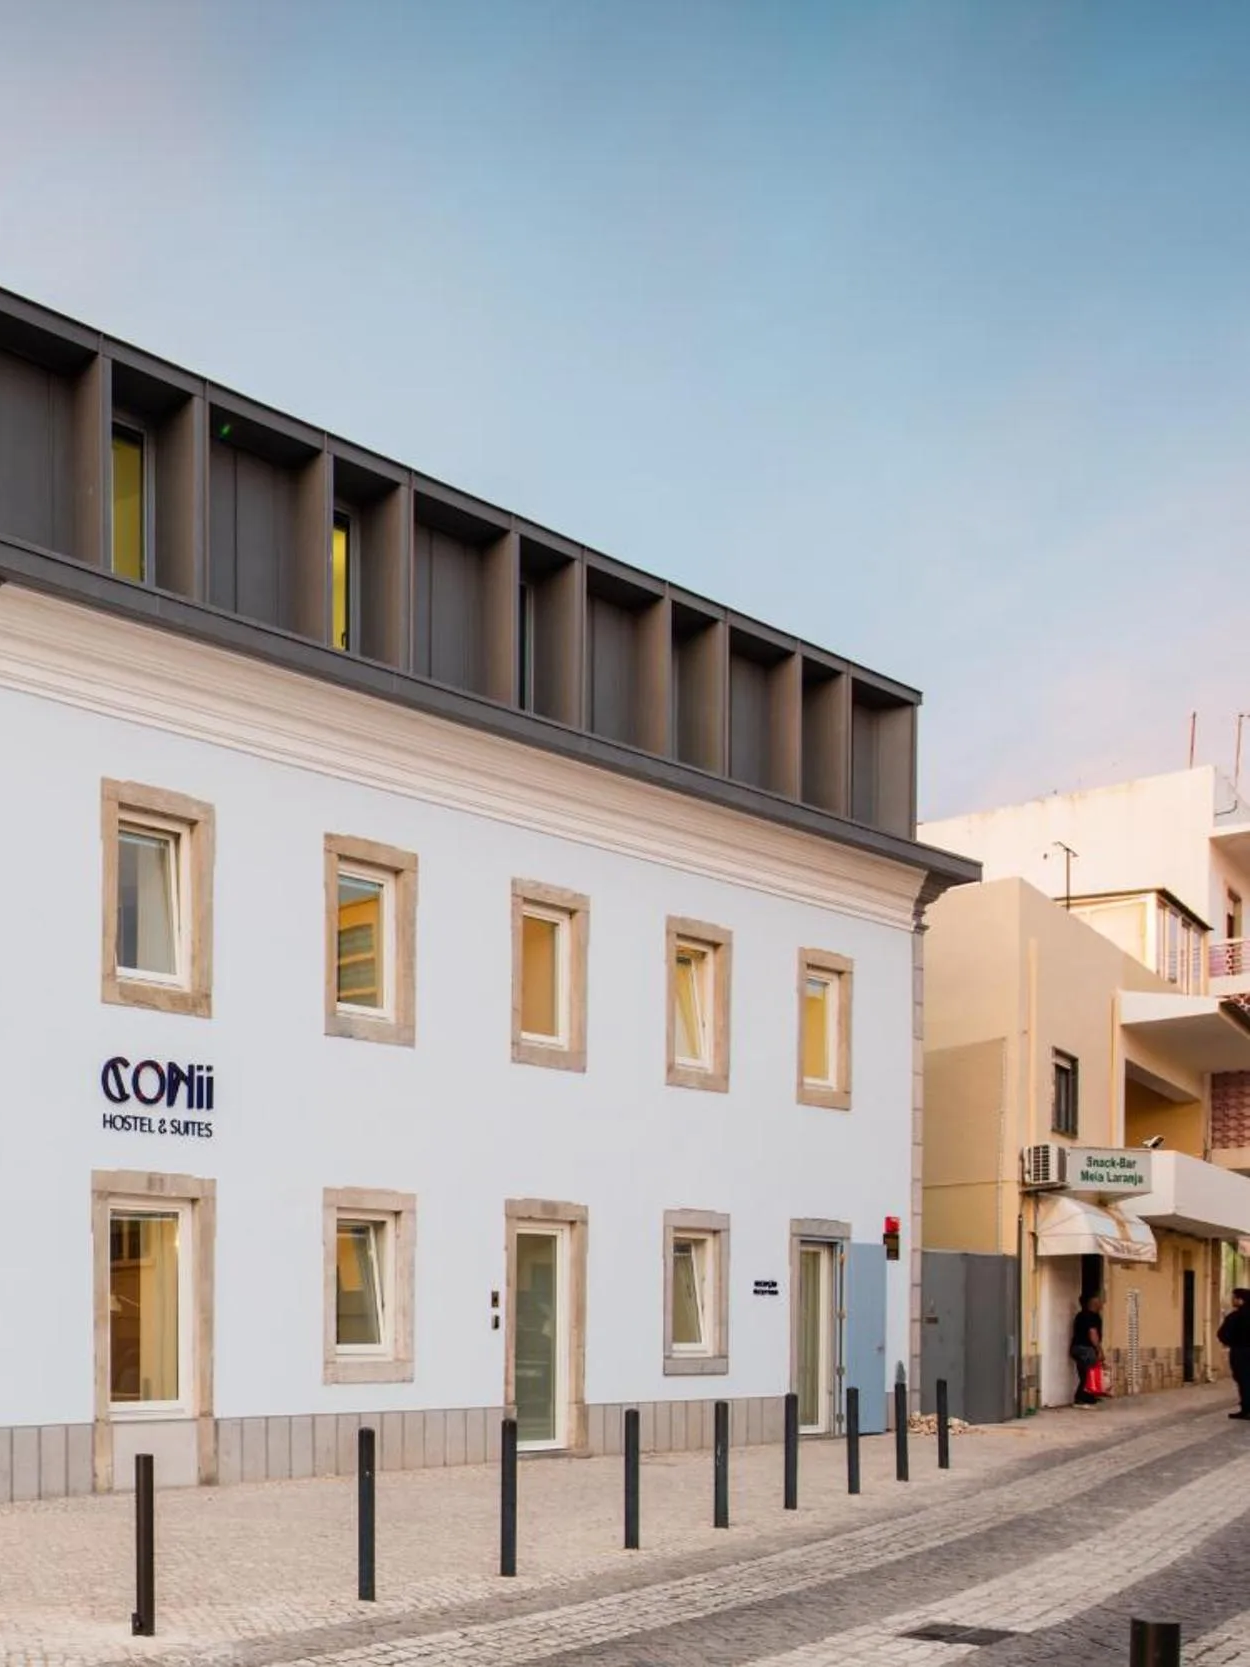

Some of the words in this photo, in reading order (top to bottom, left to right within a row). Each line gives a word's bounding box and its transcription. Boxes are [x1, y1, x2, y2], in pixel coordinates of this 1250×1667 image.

[102, 1112, 155, 1133] HOSTEL
[158, 1118, 167, 1134] &
[170, 1118, 213, 1138] SUITES
[1086, 1155, 1137, 1169] Snack-Bar
[1080, 1170, 1104, 1183] Meia
[1106, 1171, 1144, 1187] Laranja
